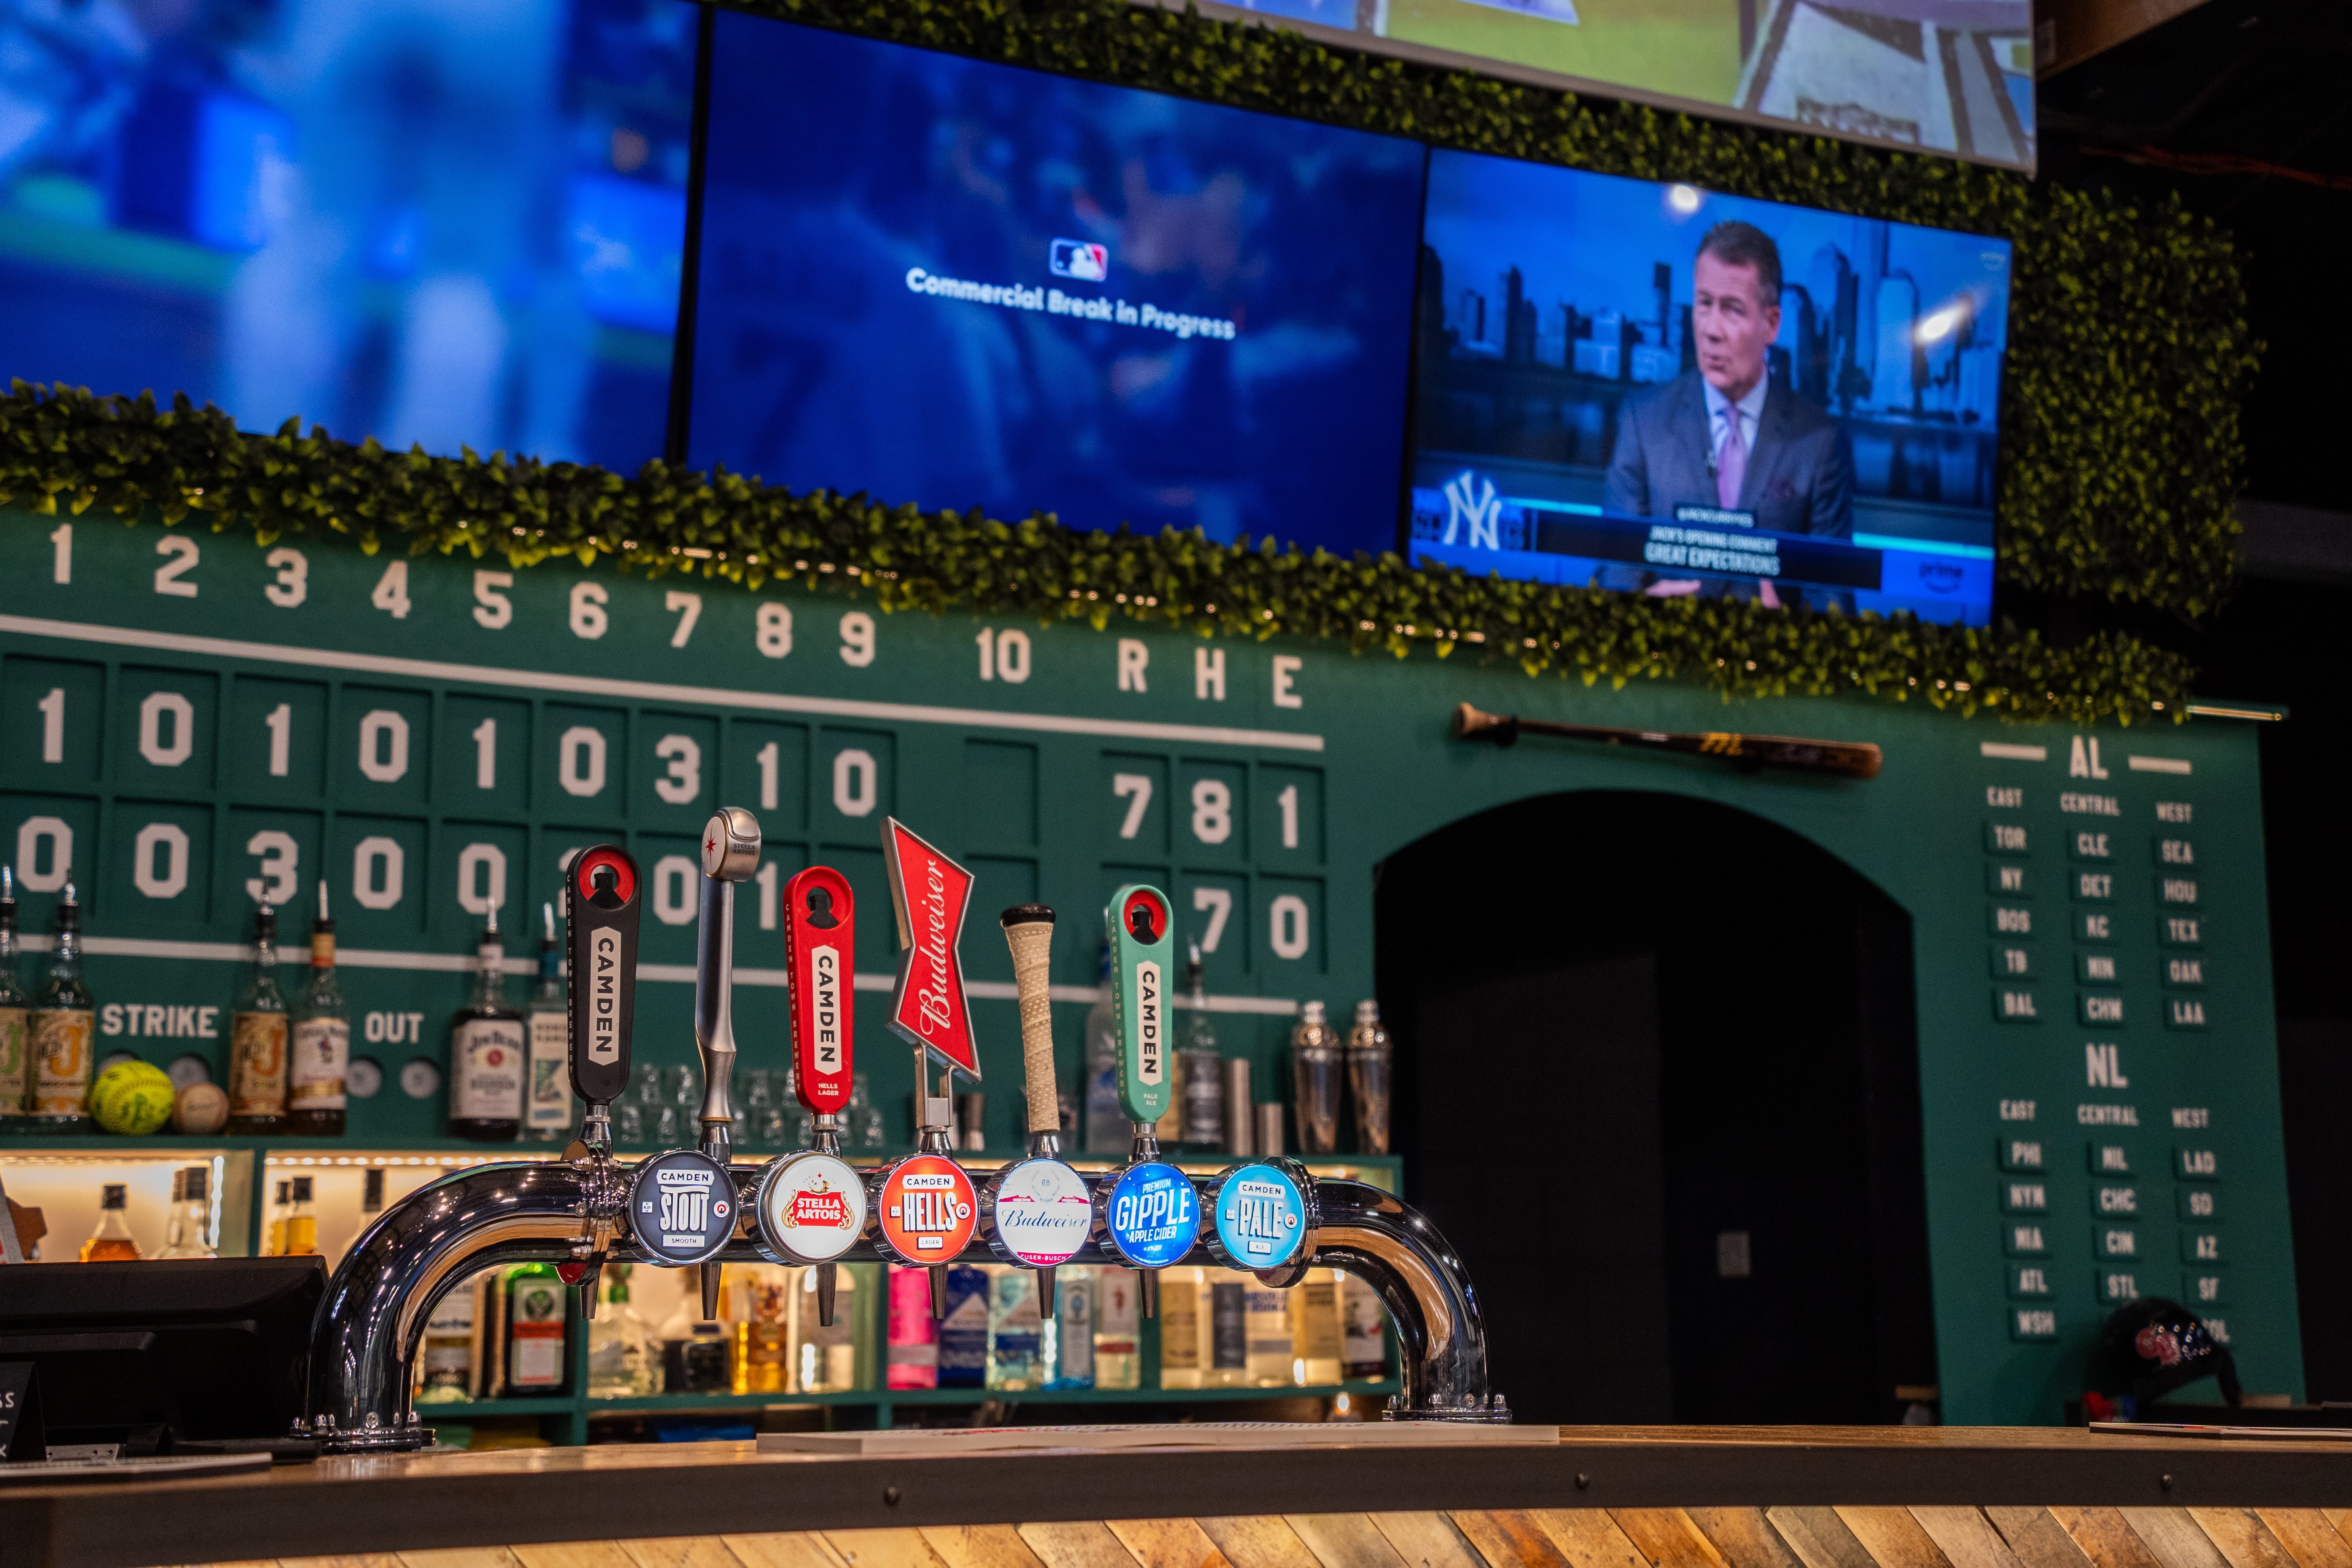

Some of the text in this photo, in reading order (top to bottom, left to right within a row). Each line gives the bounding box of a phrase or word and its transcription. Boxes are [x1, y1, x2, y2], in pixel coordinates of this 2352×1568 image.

[906, 267, 1235, 341] Commercial Break in Progress
[1645, 542, 1781, 576] GREAT EXPECTATIONS
[50, 523, 1302, 709] 1 2 3 4 5 6 7 8 9 10 R H E
[38, 688, 1298, 849] 1 0 1 0 1 0 3 1 0 7 8 1
[2070, 735, 2108, 780] AL
[1986, 786, 2023, 808] EAST
[2061, 793, 2121, 816] CENTRAL
[2156, 802, 2192, 823] WEST
[2077, 833, 2109, 857] CLE
[16, 816, 73, 893] 0
[134, 823, 189, 899] 0
[246, 830, 298, 905] 3
[353, 836, 404, 910] 0
[457, 843, 506, 915] 0
[653, 855, 699, 925] 0
[755, 861, 777, 930] 1
[1194, 888, 1232, 953] 7
[1270, 894, 1308, 960] 0
[2168, 919, 2199, 942] TEX
[919, 859, 951, 1035] Budweiser
[596, 937, 615, 1052] CAMDEN
[101, 1003, 219, 1039] STRIKE
[818, 955, 835, 1063] CAMDEN
[2174, 1001, 2205, 1025] LAA
[365, 1011, 424, 1044] OUT
[1142, 970, 1157, 1074] CAMDEN
[2086, 1043, 2128, 1089] NL
[2000, 1100, 2036, 1121] EAST
[2077, 1104, 2139, 1127] CENTRAL
[2172, 1108, 2209, 1128] WEST
[2012, 1141, 2041, 1166] PHI
[661, 1173, 709, 1182] CAMDEN
[1142, 1178, 1171, 1194] PREMIUM
[1242, 1185, 1281, 1194] CAMDEN
[659, 1185, 710, 1232] STOUT
[797, 1197, 841, 1209] STELLA
[1116, 1188, 1190, 1231] GIPPLE
[2100, 1188, 2136, 1211] CHC
[796, 1209, 841, 1220] ARTOIS
[903, 1192, 957, 1232] HELLS
[1001, 1209, 1088, 1228] Budweiser
[1238, 1198, 1284, 1239] PALE
[1129, 1226, 1177, 1243] APPLE CIDER
[2106, 1231, 2134, 1255] CIN
[2197, 1236, 2218, 1259] AZ
[2020, 1269, 2048, 1293] ATL
[2108, 1274, 2139, 1299] STL
